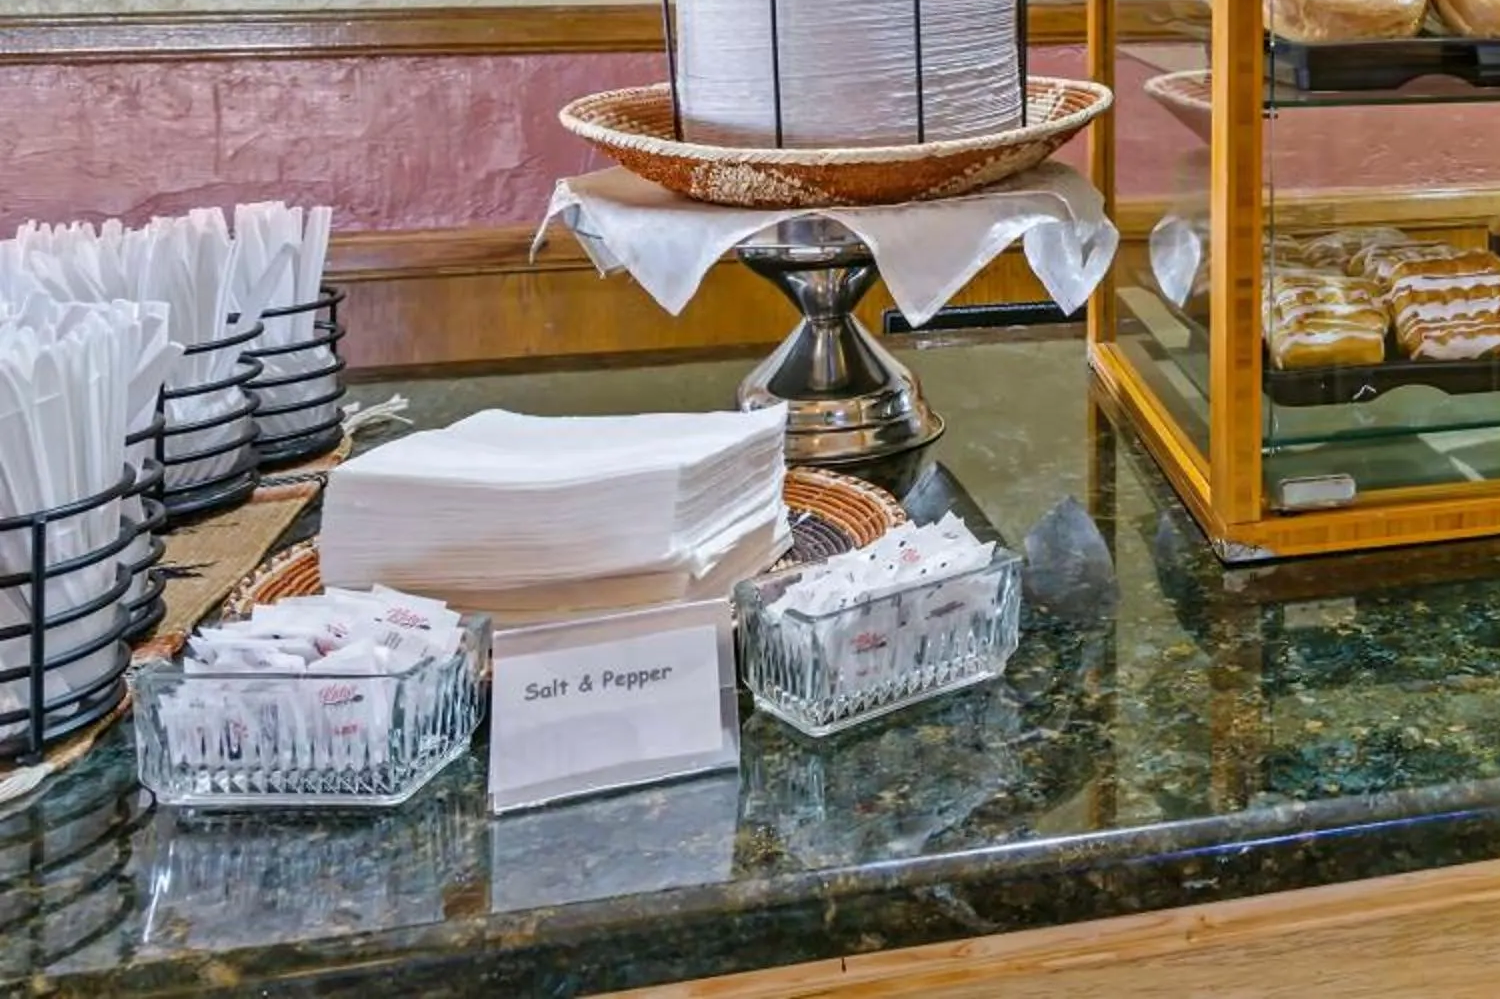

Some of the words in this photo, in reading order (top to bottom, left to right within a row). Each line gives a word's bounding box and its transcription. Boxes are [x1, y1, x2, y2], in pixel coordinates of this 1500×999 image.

[524, 679, 569, 701] Salt
[578, 674, 593, 692] &
[602, 667, 673, 690] Pepper
